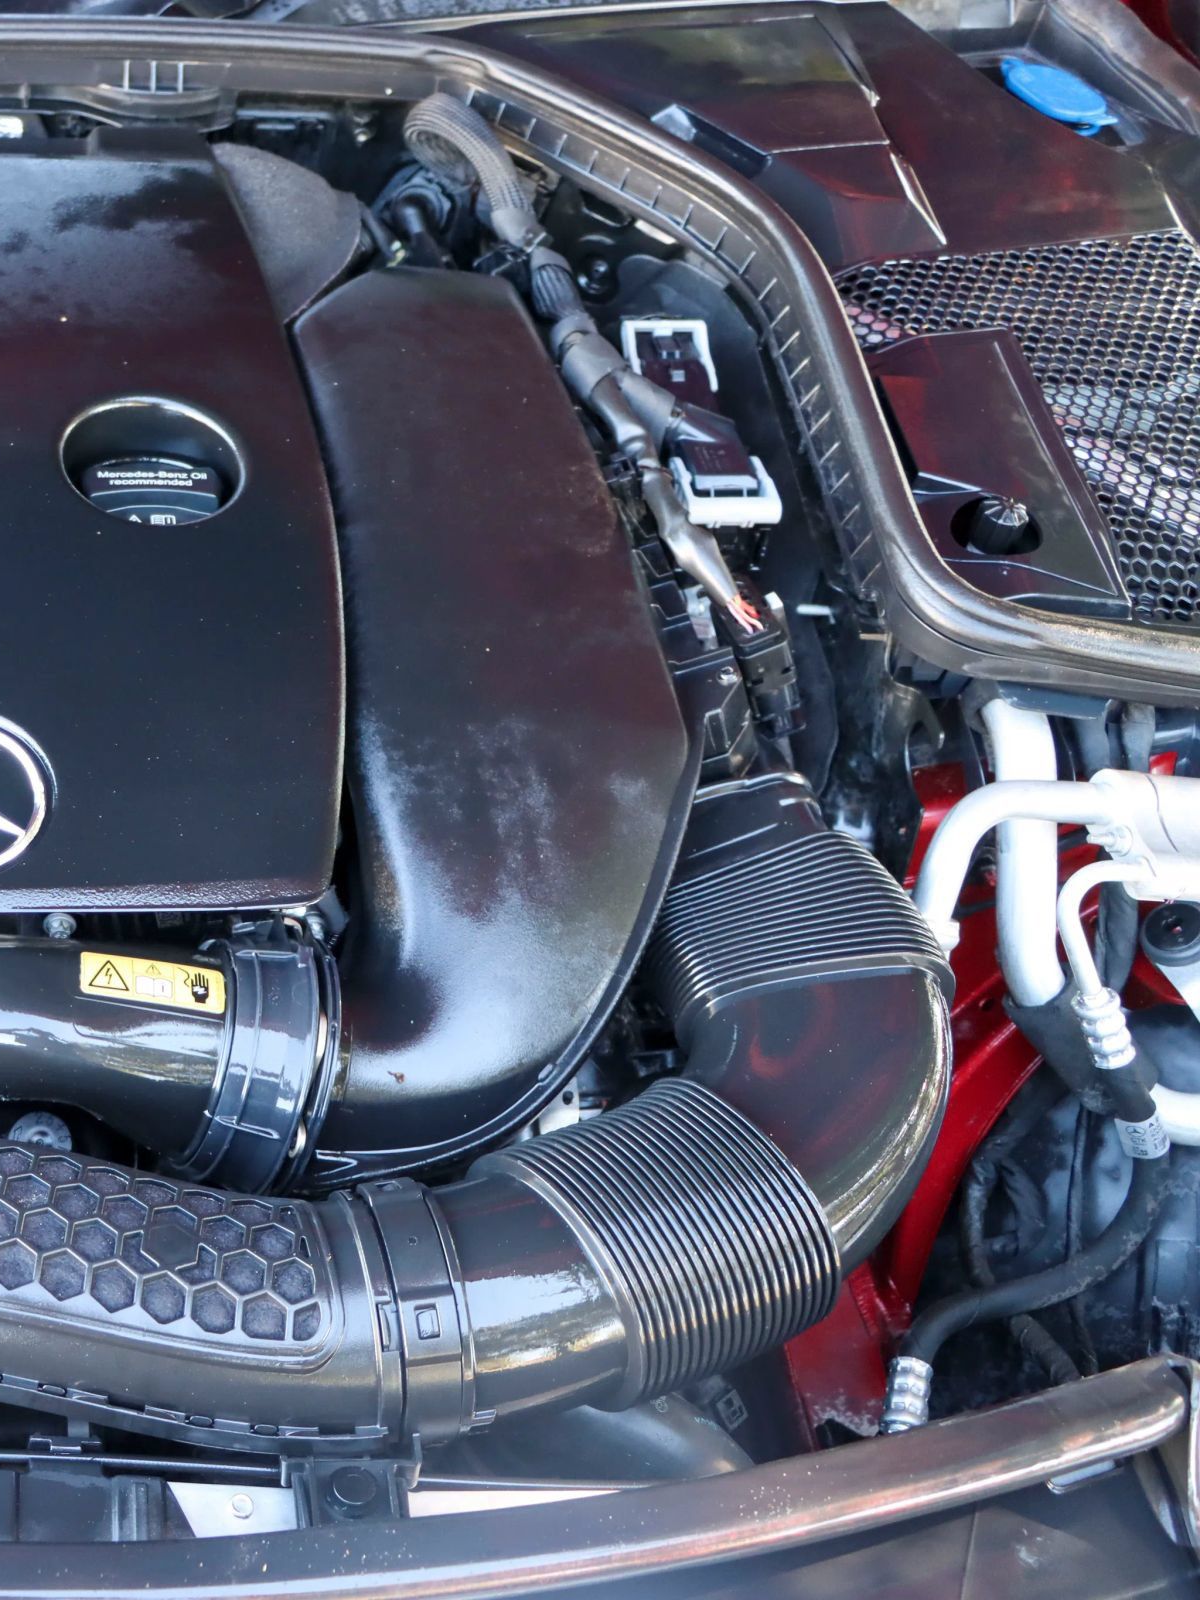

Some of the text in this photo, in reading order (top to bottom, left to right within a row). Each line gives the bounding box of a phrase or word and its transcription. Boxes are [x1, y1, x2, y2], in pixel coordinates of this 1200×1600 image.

[97, 470, 208, 480] Mercedes-Benz Oil
[109, 479, 193, 487] recommended
